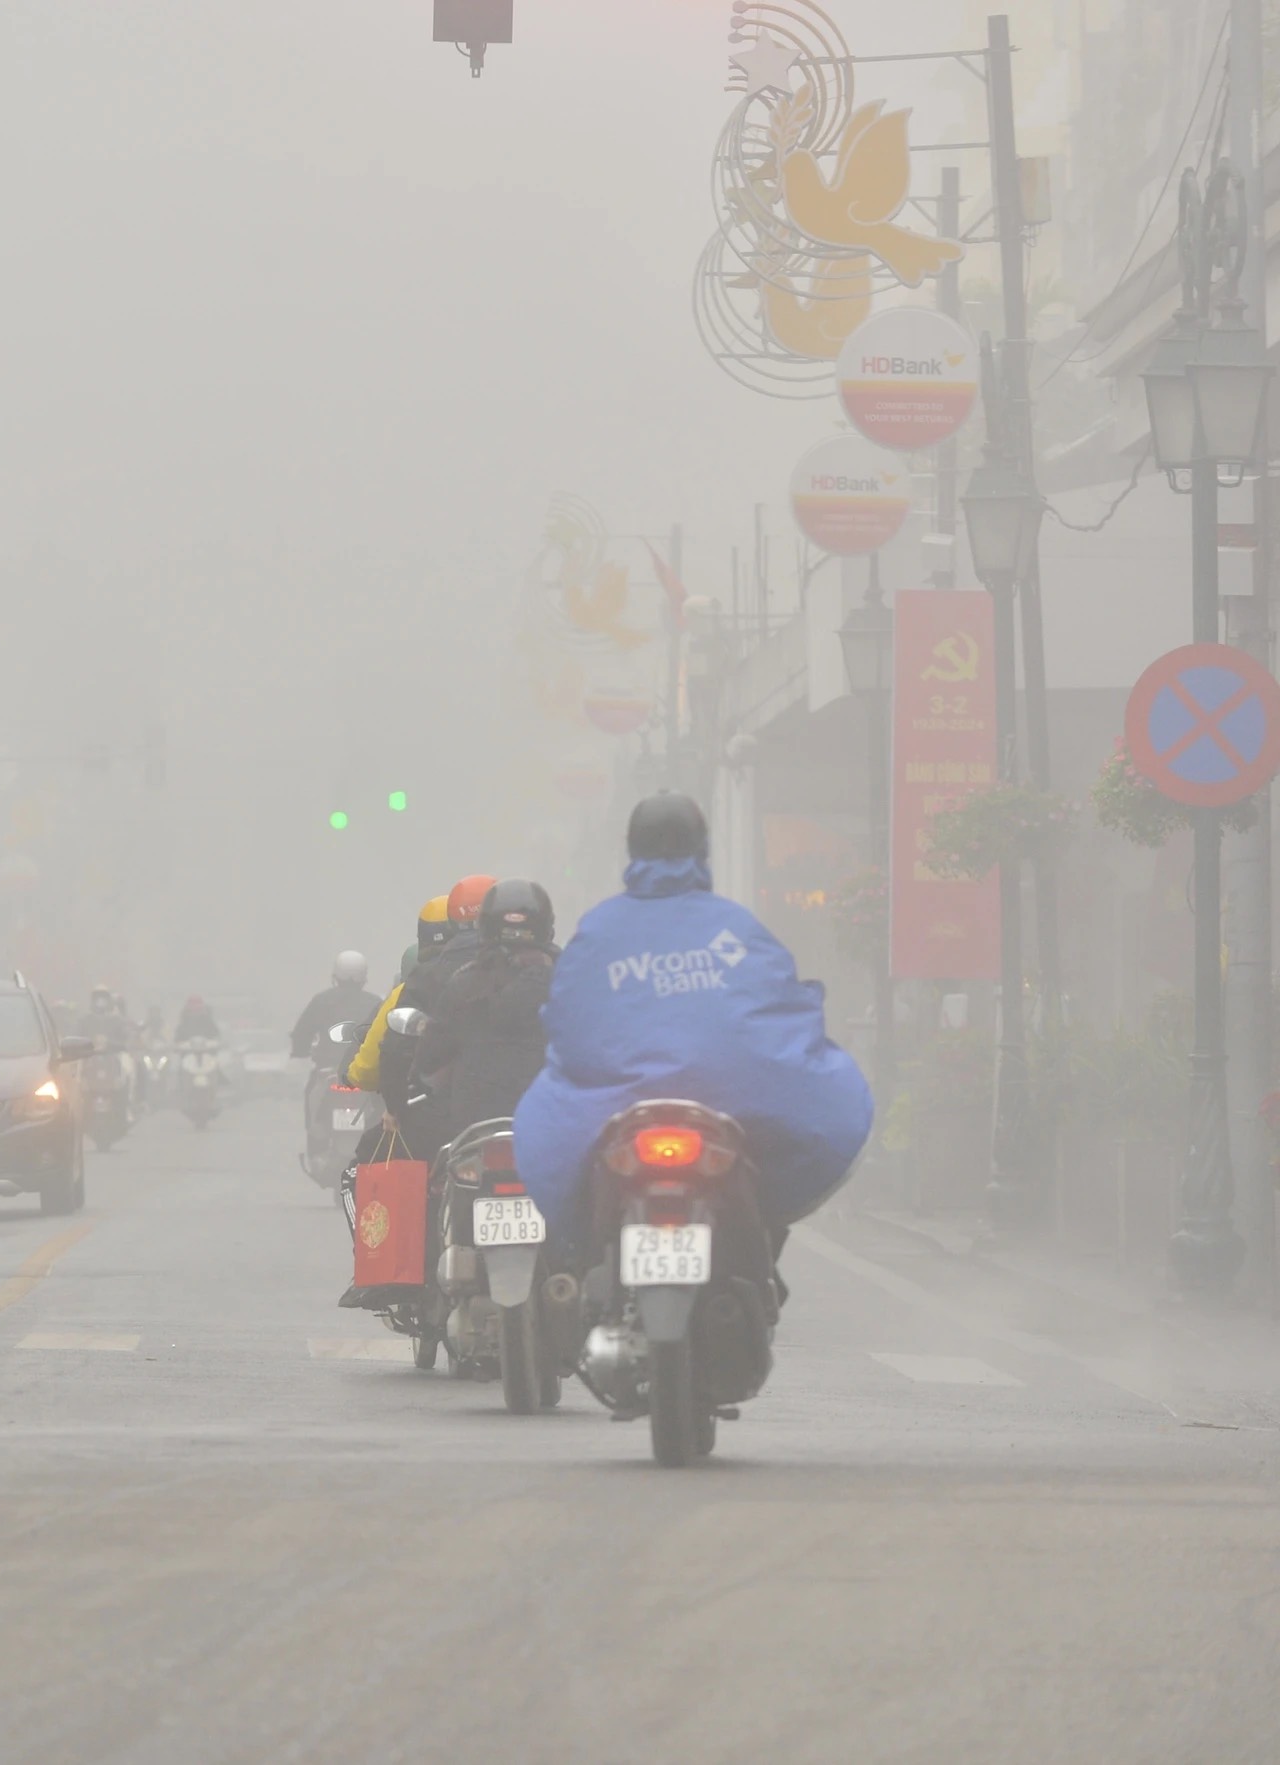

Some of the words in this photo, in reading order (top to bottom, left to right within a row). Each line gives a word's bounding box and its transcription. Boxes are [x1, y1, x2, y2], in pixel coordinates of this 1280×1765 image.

[861, 356, 943, 376] HDBank
[810, 475, 880, 492] HDBank
[929, 694, 969, 715] 3-2
[606, 949, 713, 993] PVcom
[652, 969, 729, 999] Bank
[485, 1200, 533, 1222] 29-B1
[479, 1221, 540, 1242] 970.83
[635, 1228, 697, 1254] 29-B2
[630, 1255, 704, 1280] 145.83
